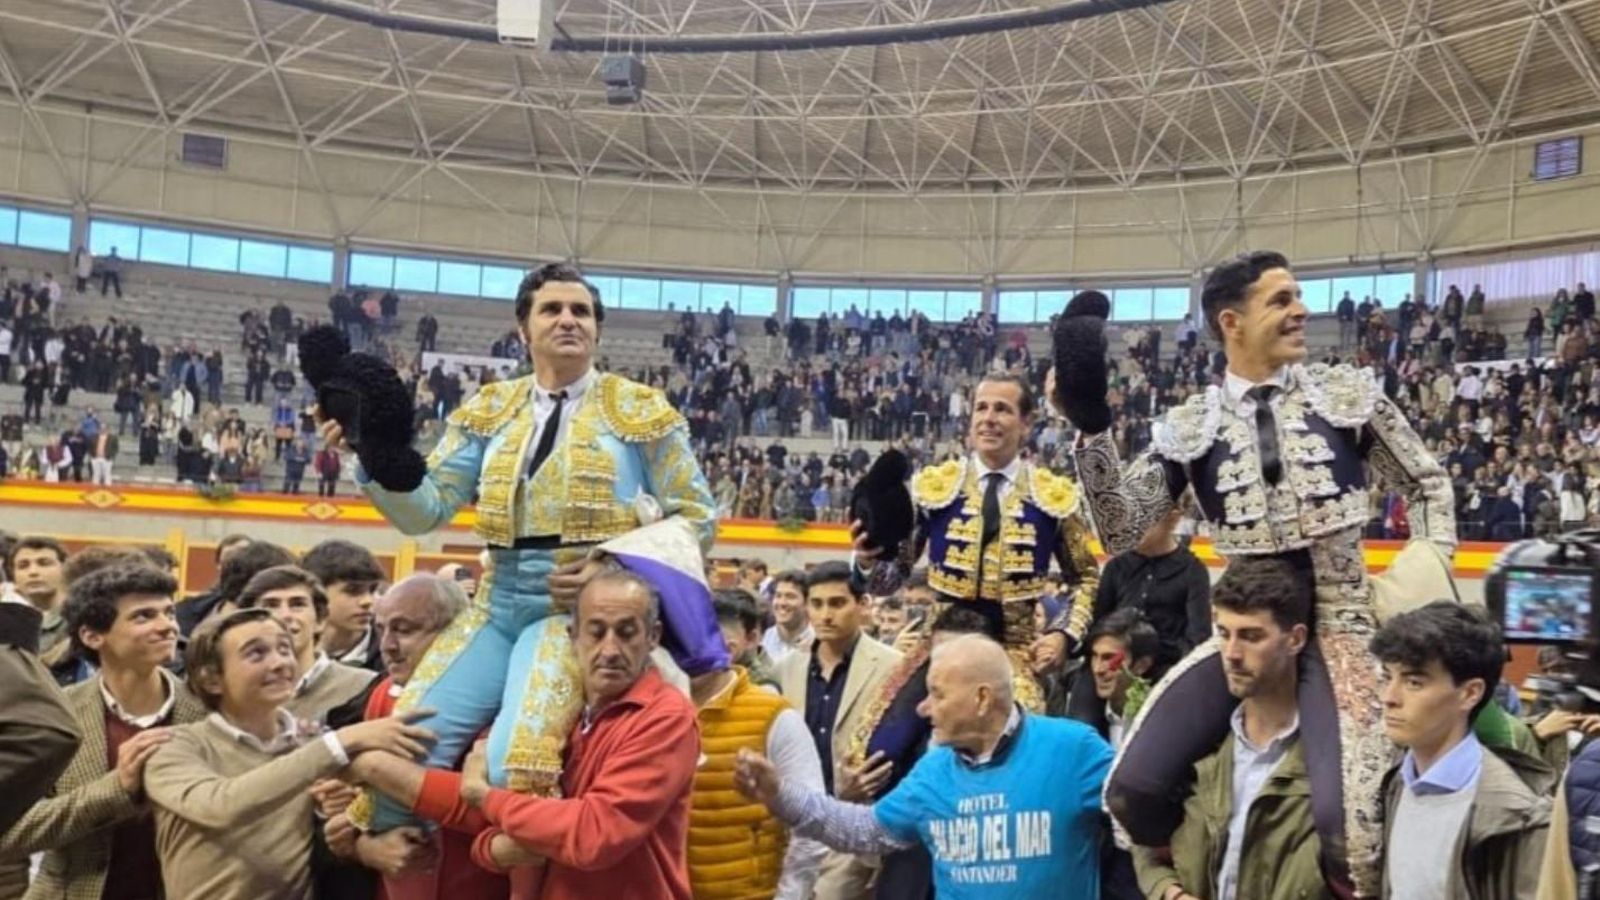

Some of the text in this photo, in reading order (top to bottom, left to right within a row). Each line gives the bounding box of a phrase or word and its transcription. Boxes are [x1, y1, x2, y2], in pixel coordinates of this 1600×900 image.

[957, 793, 1009, 813] HOTEL
[982, 814, 1011, 861] DEL
[1015, 811, 1052, 859] MAR
